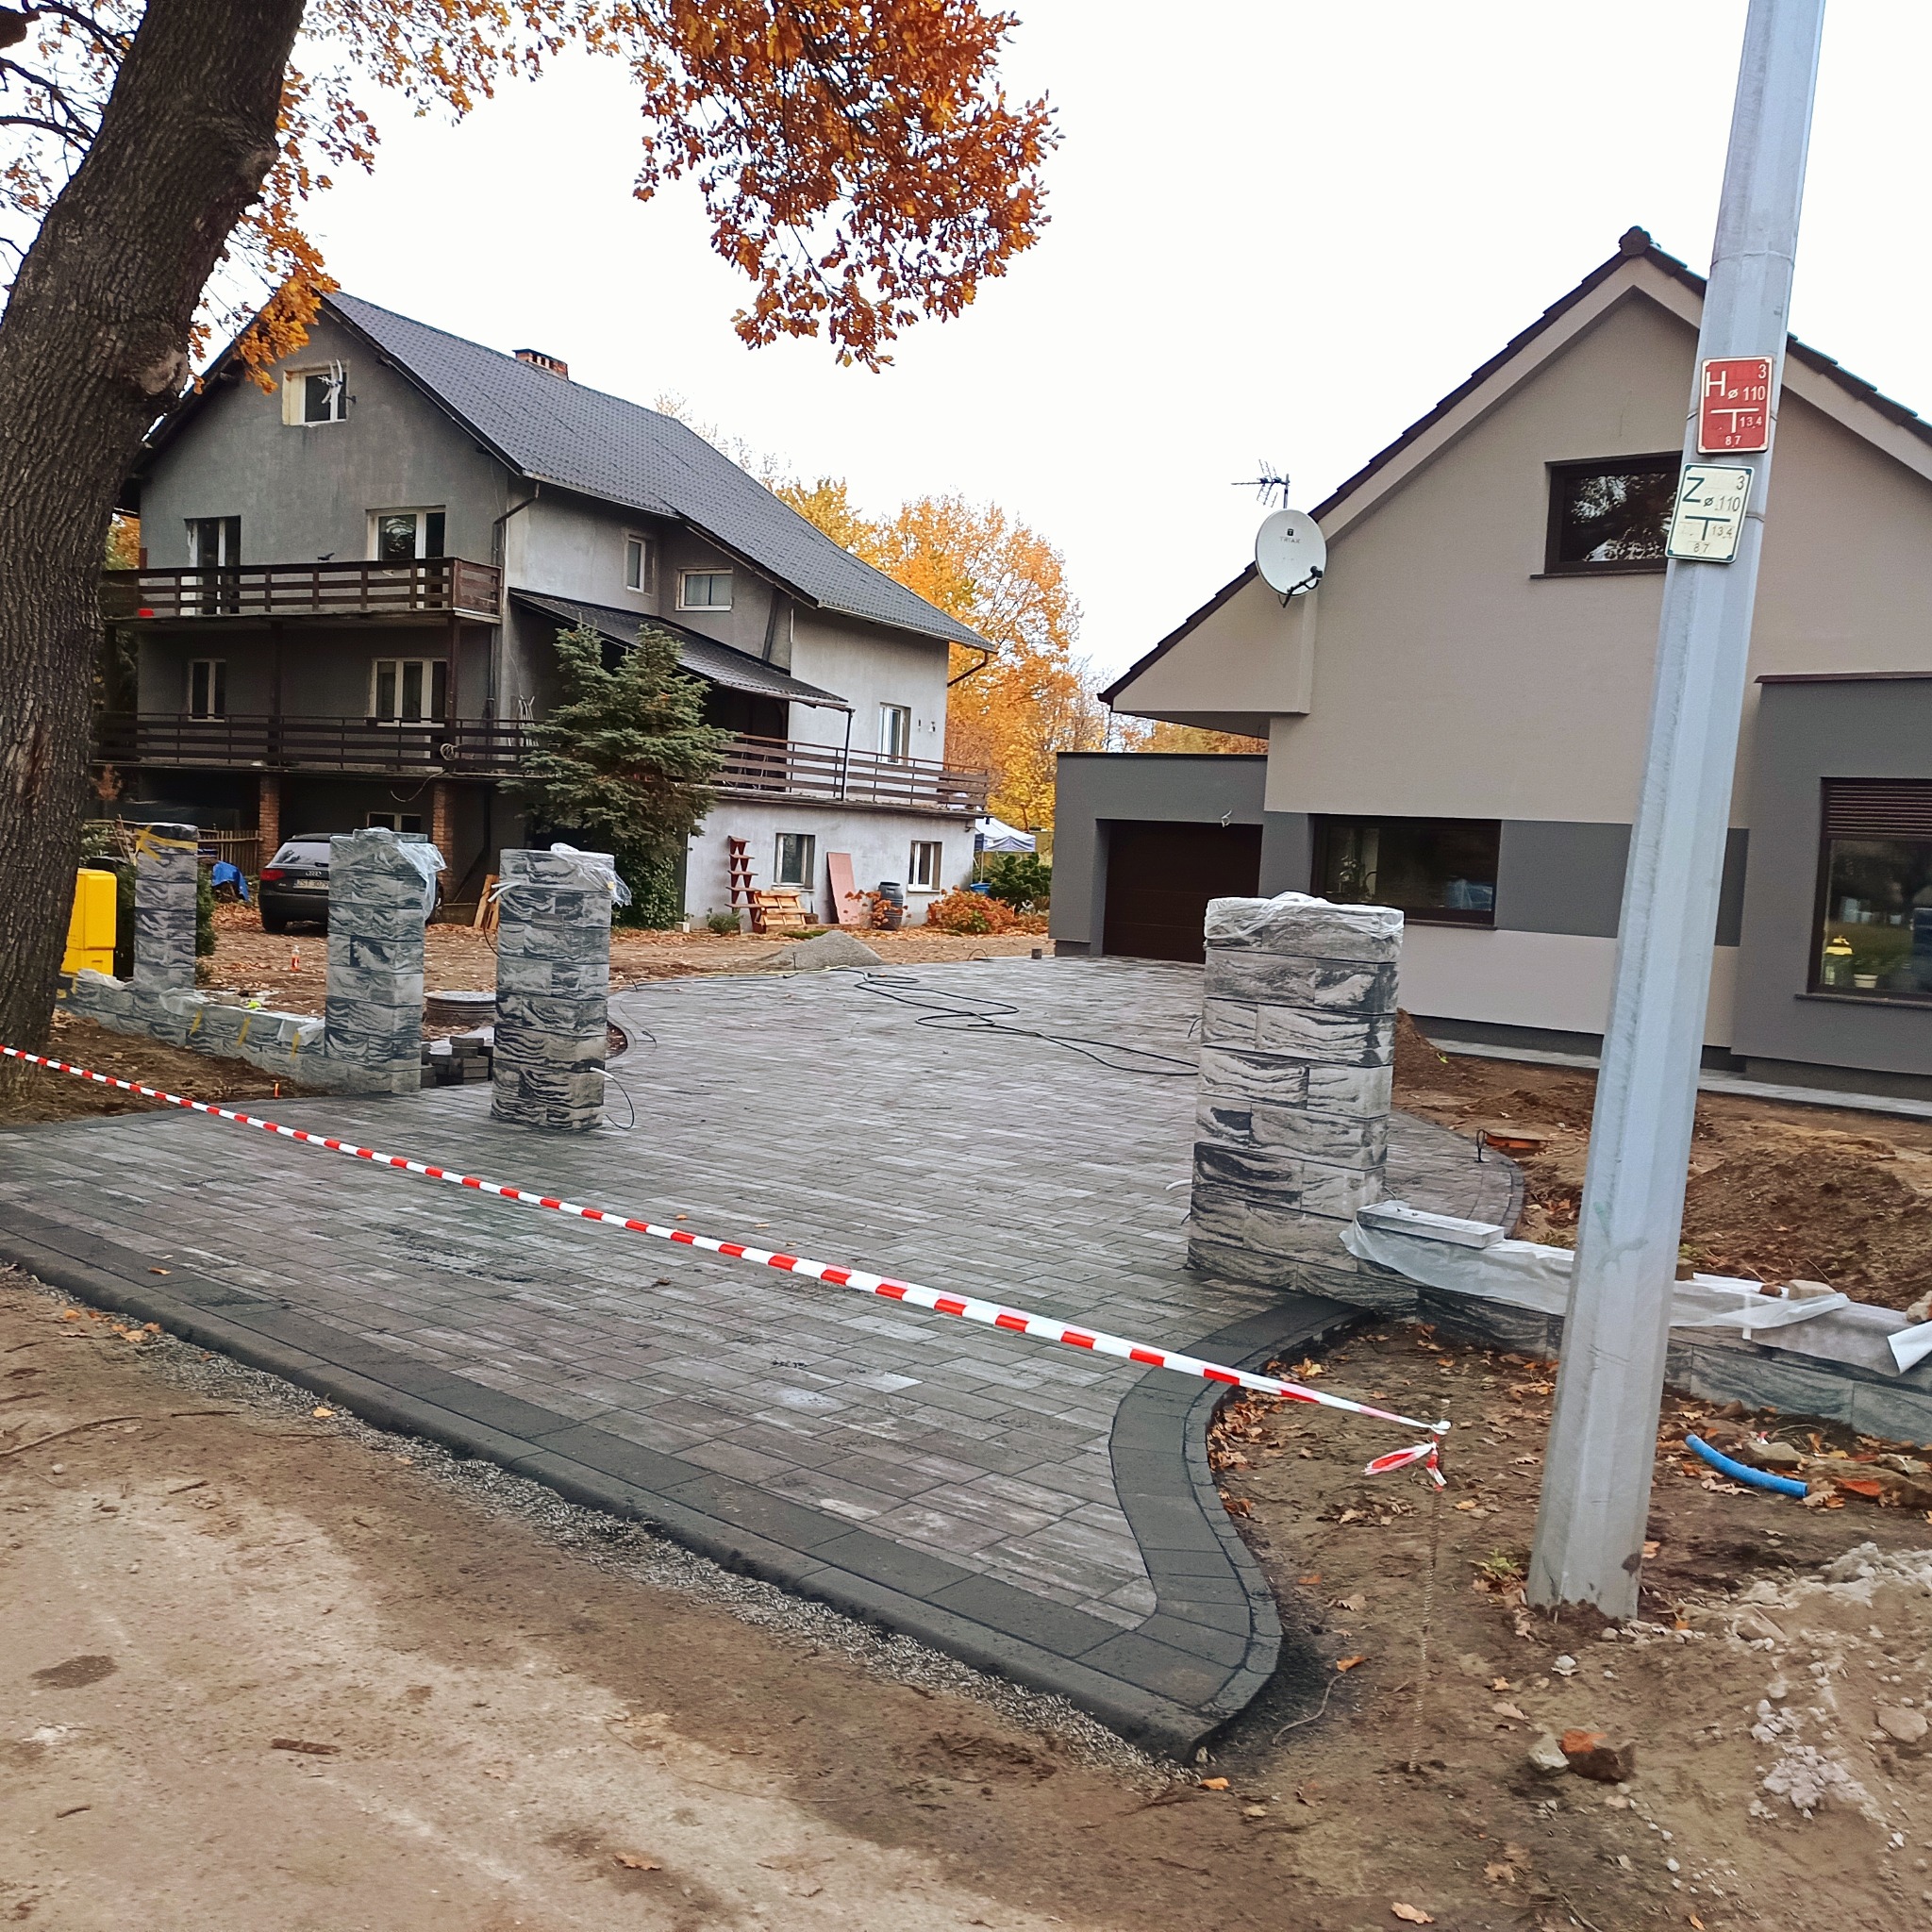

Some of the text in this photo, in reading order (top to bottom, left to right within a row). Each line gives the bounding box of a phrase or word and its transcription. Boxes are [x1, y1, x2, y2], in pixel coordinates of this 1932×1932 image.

[1757, 363, 1767, 379] 3
[1705, 371, 1726, 397] H
[1742, 385, 1766, 401] 110
[1682, 476, 1705, 503] Z
[1736, 475, 1745, 491] 3
[1719, 495, 1741, 511] 110
